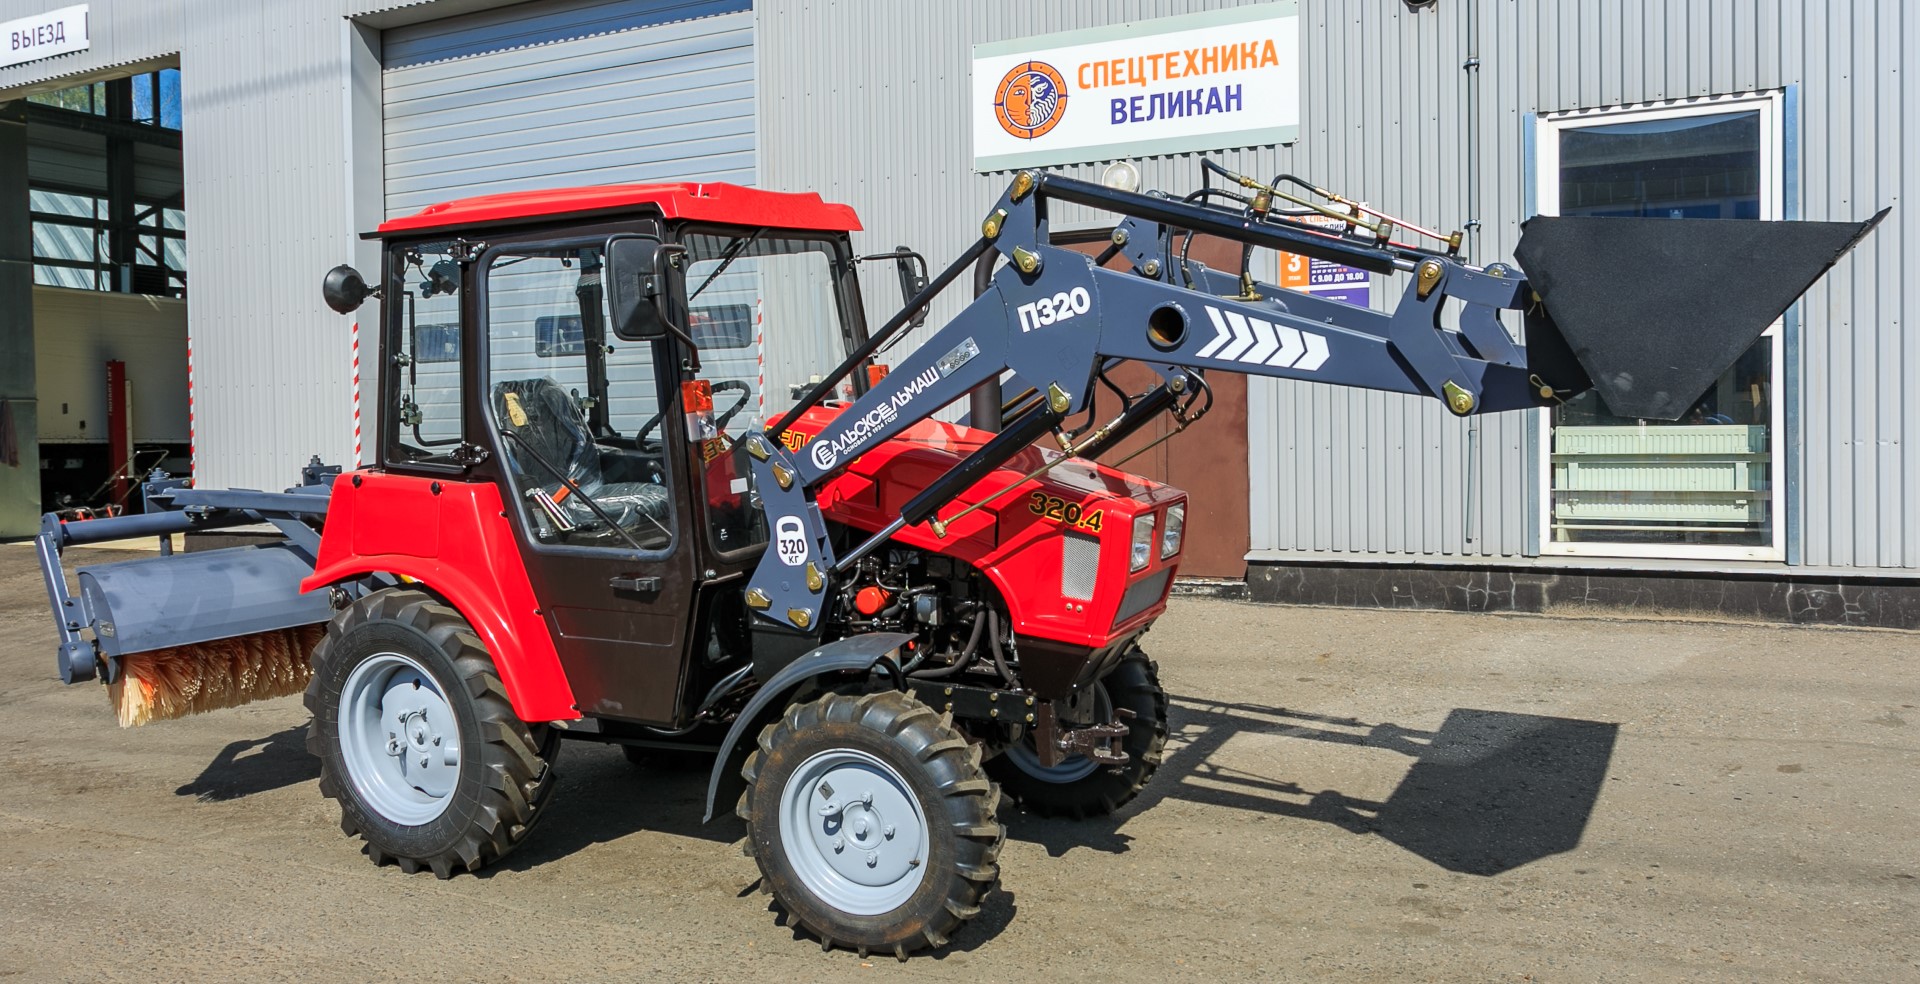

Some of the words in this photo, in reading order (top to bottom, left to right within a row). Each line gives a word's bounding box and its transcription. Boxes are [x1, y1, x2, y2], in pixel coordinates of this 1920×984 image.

[12, 21, 65, 51] ВЫЕЗД
[1077, 38, 1280, 90] СПЕЦТЕХНИКА
[1110, 83, 1243, 125] ВЕЛИКАН
[1287, 253, 1301, 273] 3
[1311, 274, 1317, 283] С
[1318, 274, 1333, 283] 9.00
[1334, 273, 1345, 283] ДО
[1345, 272, 1364, 281] 18.00
[1017, 286, 1091, 333] П320
[1028, 491, 1105, 533] 320.4
[780, 538, 805, 555] 320
[788, 555, 800, 564] КГ
